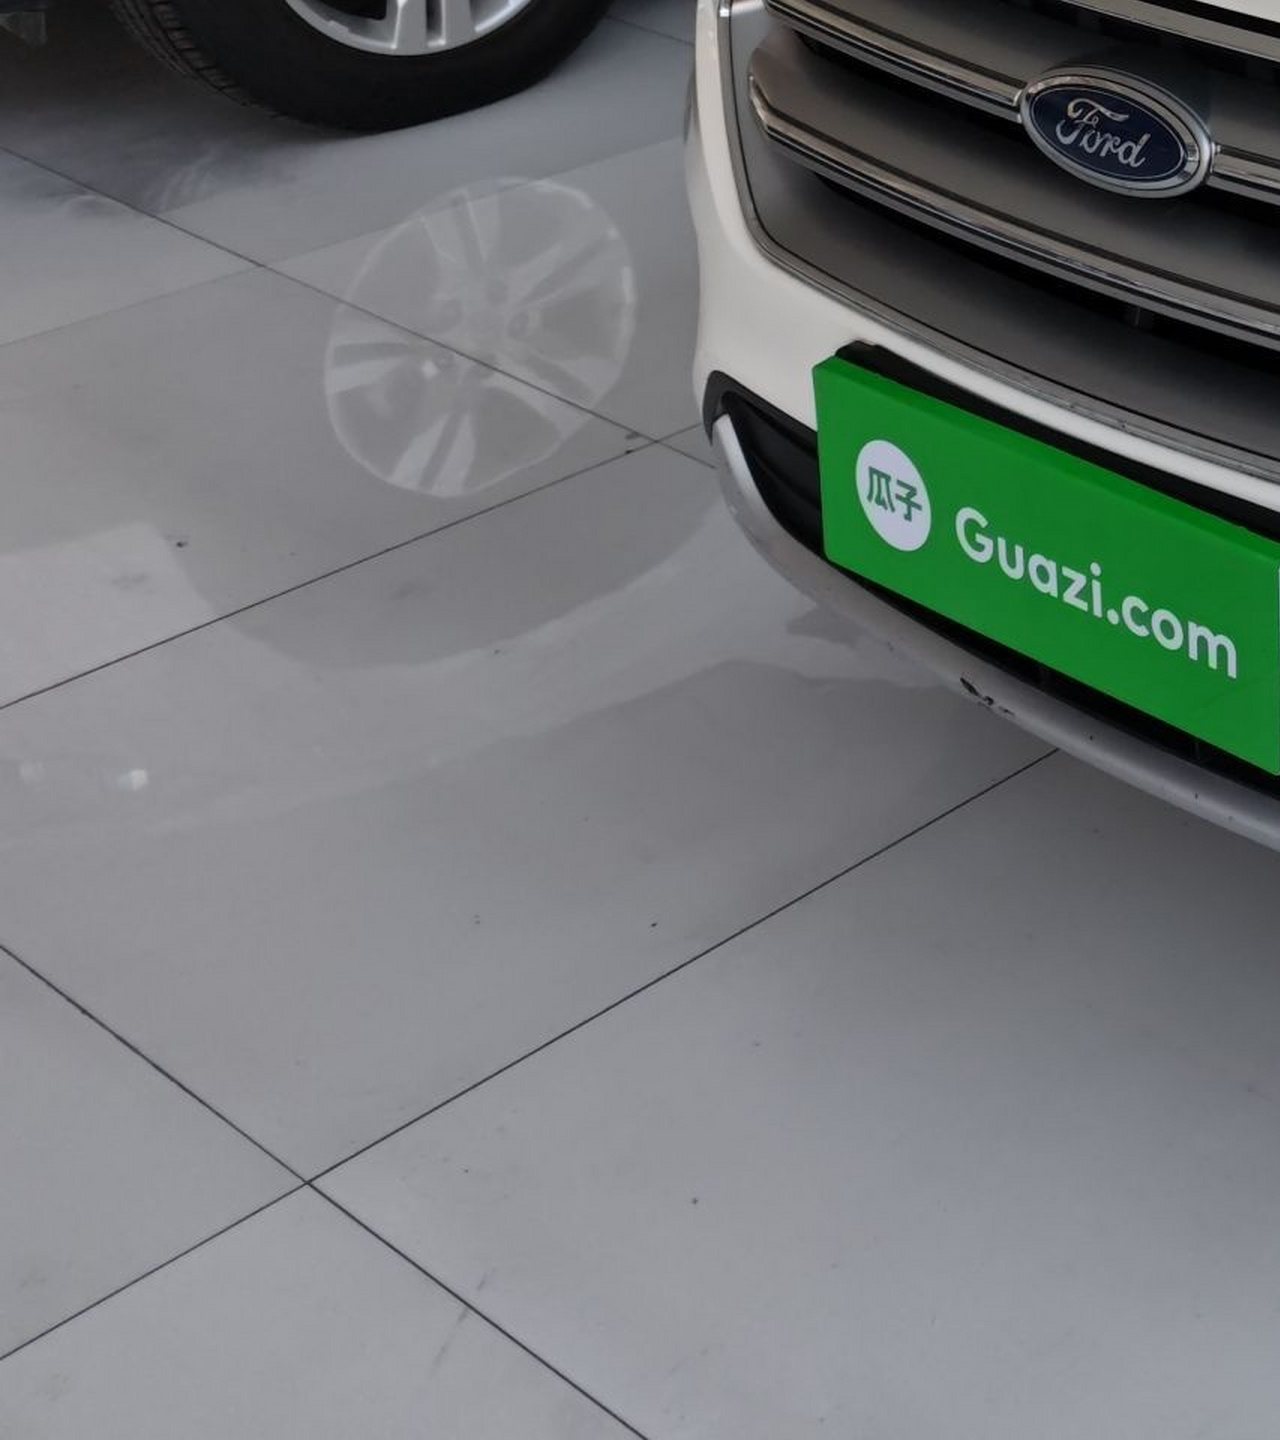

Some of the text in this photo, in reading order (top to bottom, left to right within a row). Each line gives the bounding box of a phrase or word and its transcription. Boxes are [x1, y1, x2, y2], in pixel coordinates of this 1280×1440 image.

[1055, 97, 1152, 169] Ford
[866, 466, 923, 523] 瓜子
[954, 506, 1238, 680] Guazi.com
